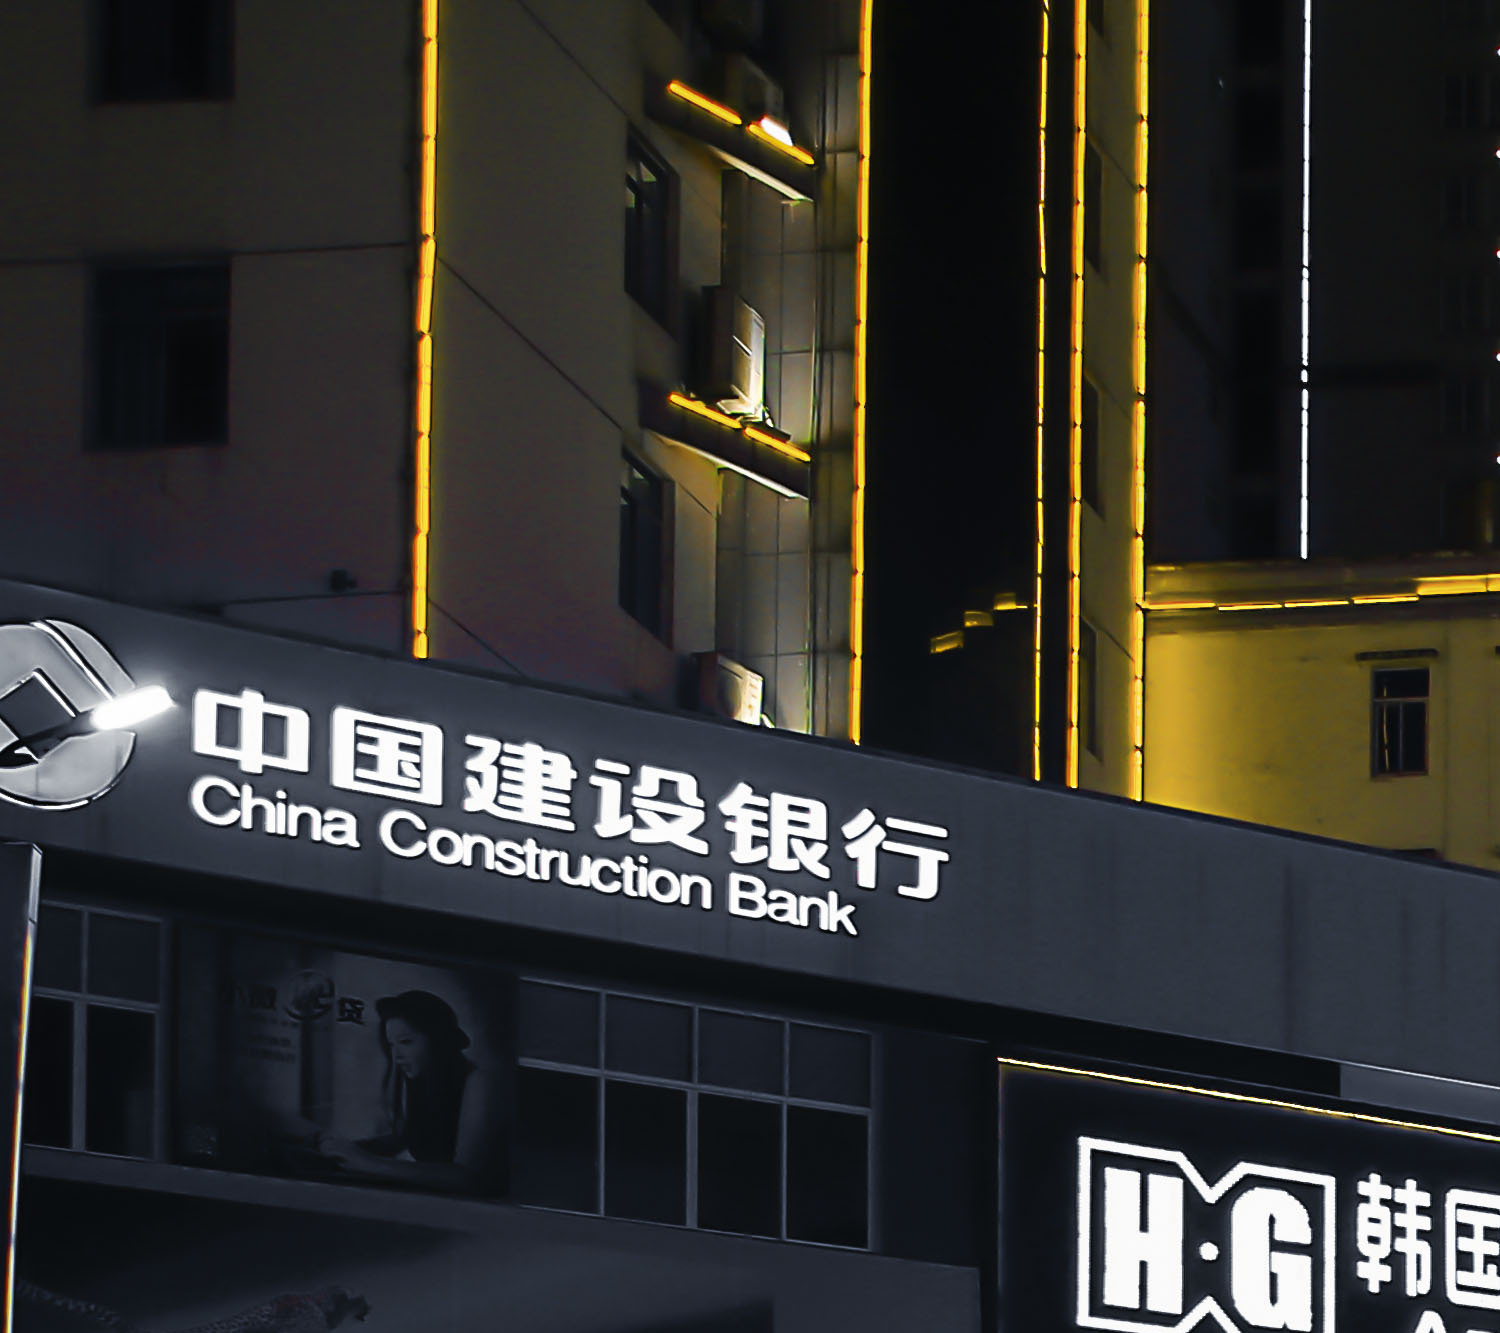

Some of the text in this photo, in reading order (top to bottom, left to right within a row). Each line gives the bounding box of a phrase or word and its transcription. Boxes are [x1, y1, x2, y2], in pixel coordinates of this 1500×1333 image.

[190, 777, 859, 936] China Construction Bank
[191, 688, 950, 900] 中国建设银行
